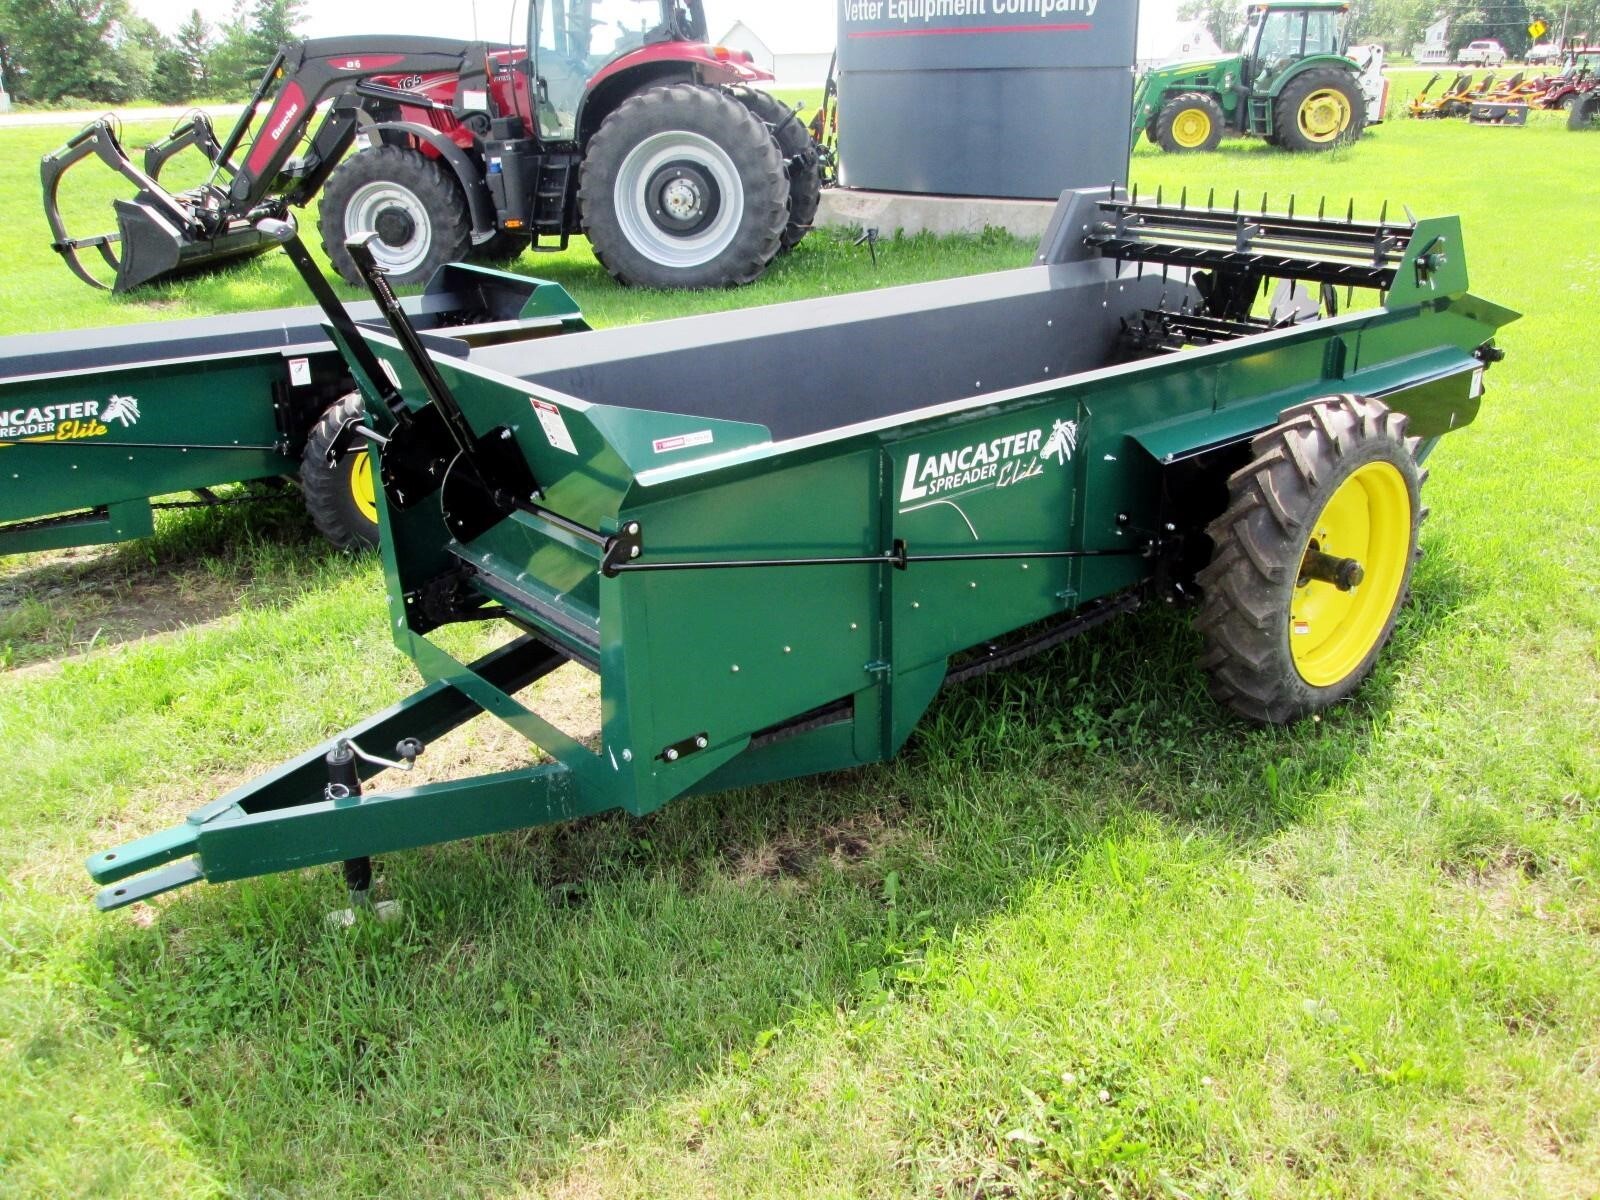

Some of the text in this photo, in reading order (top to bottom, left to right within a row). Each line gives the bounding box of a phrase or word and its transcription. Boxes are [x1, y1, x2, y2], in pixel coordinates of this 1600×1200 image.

[844, 0, 1098, 23] Vetter Equipment Company
[398, 74, 423, 91] 165
[56, 418, 108, 441] Elite
[900, 428, 1042, 502] LANCASTER
[928, 463, 997, 495] SPREADER
